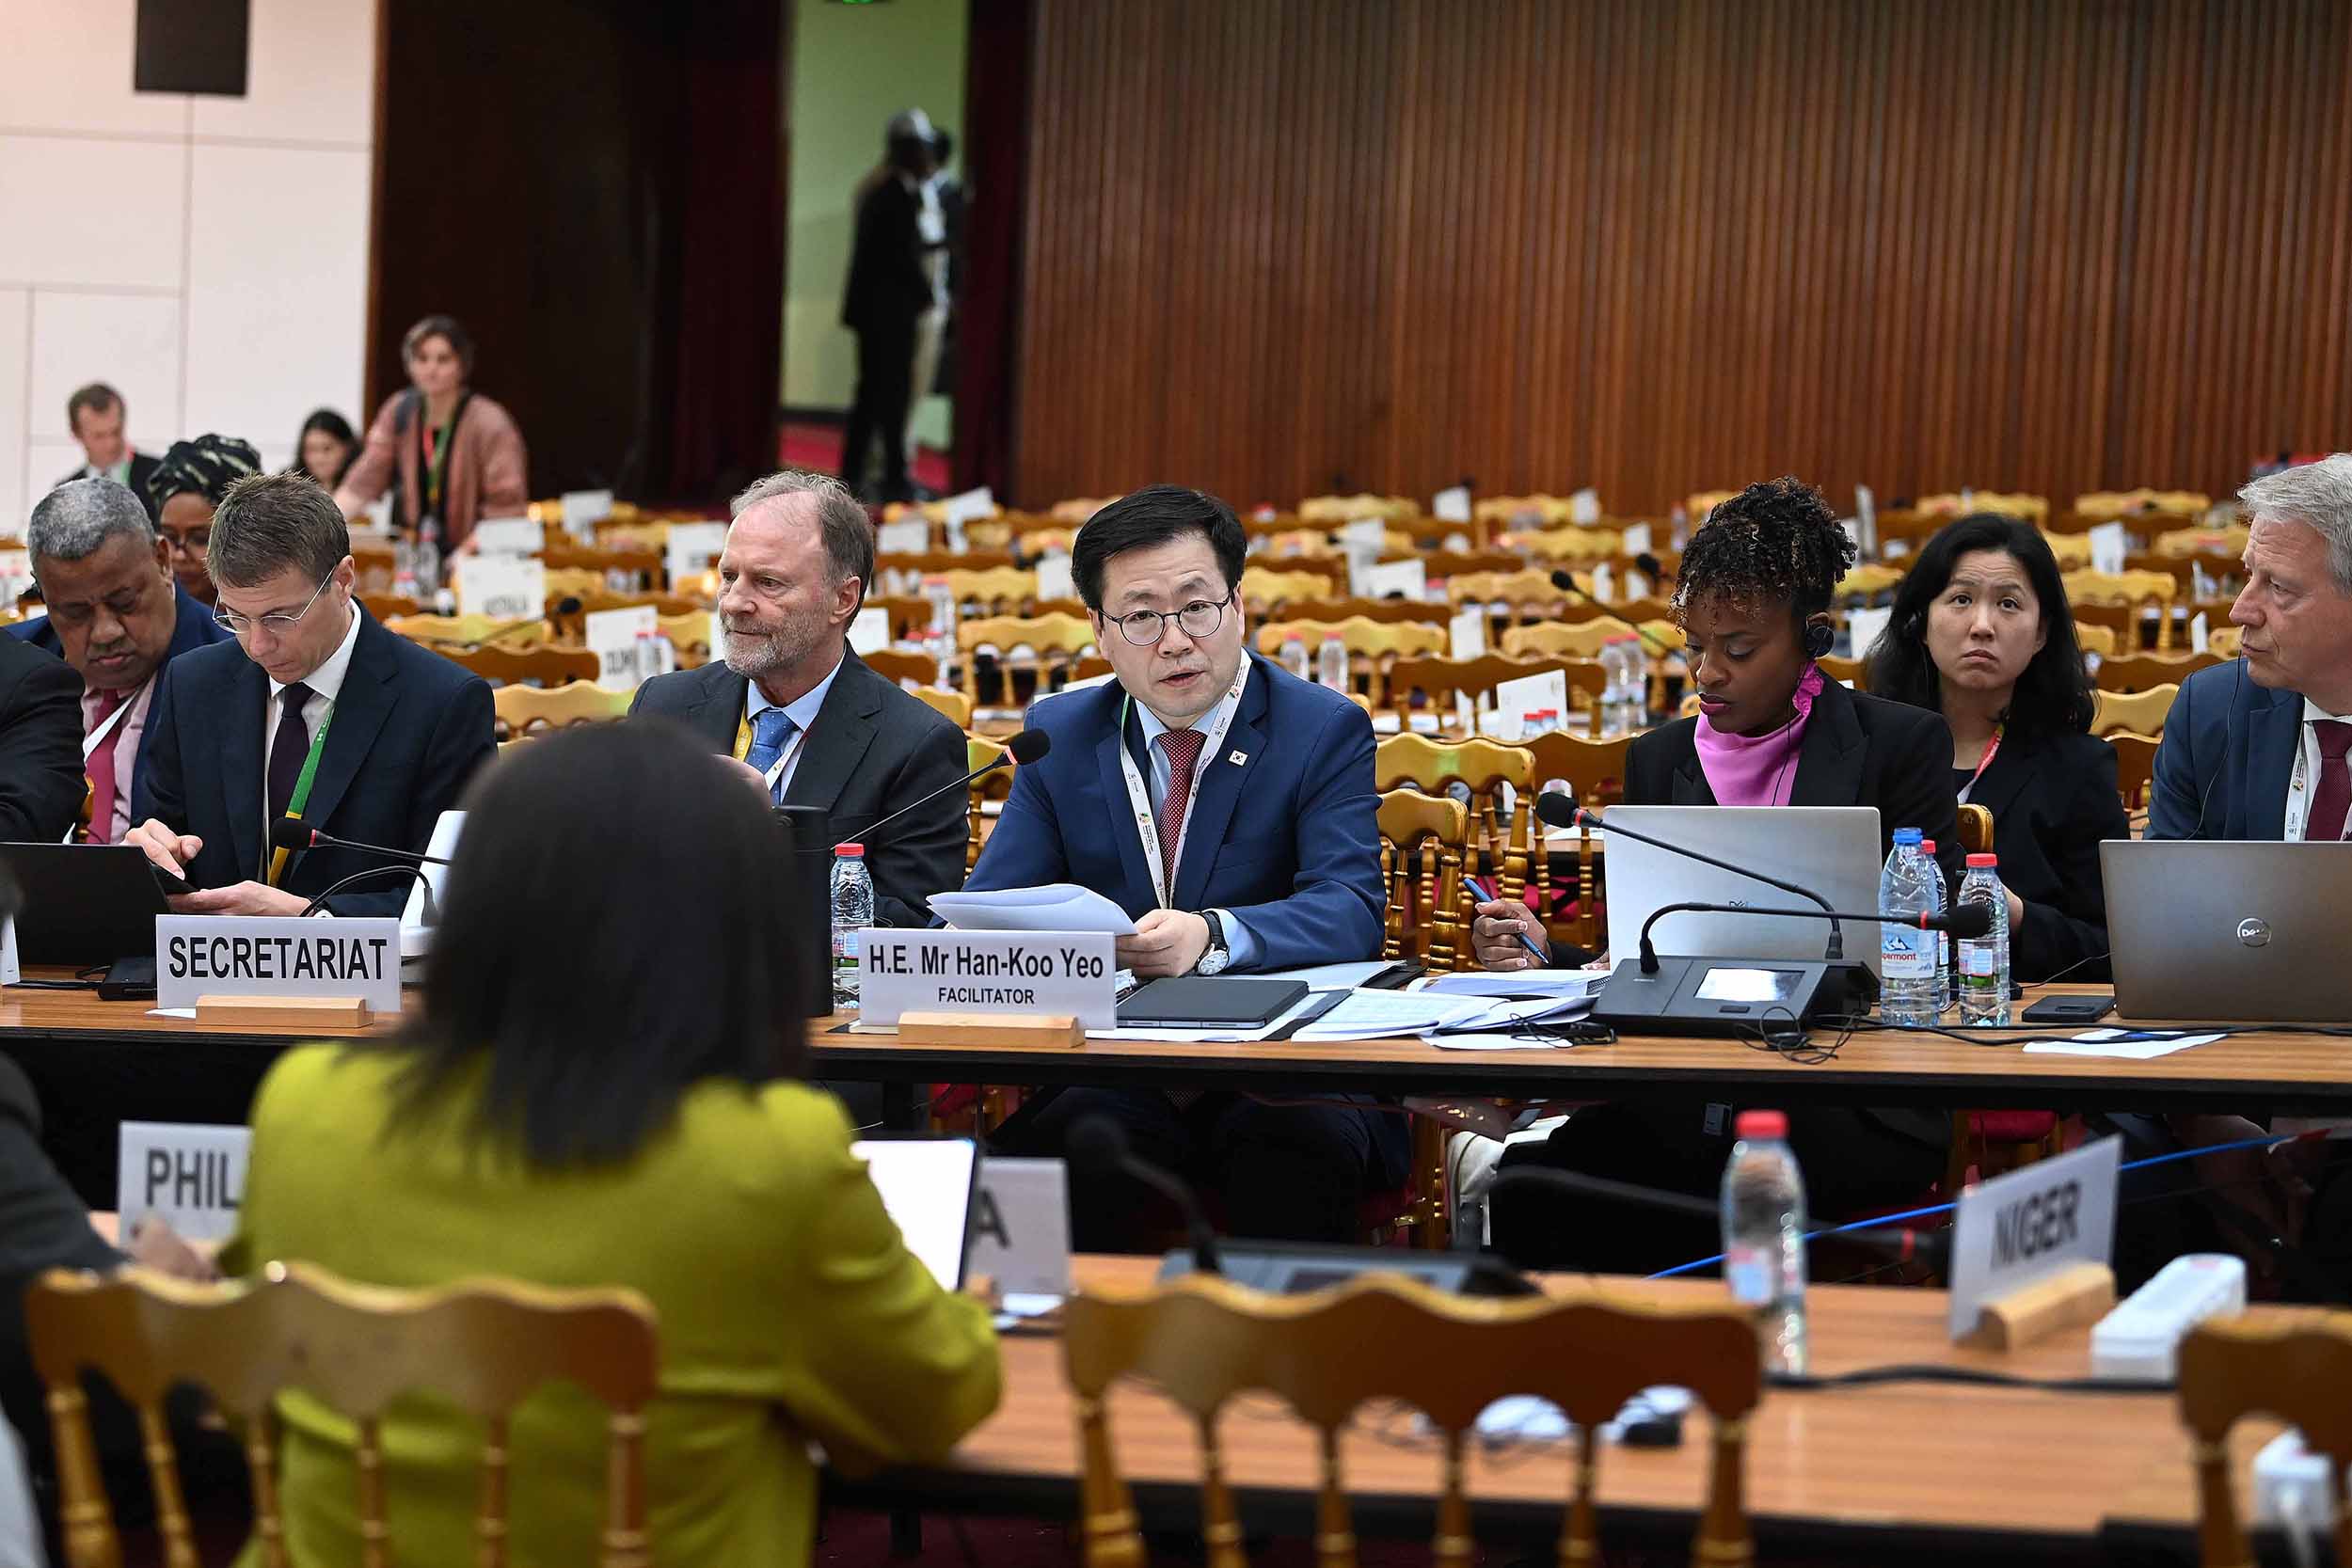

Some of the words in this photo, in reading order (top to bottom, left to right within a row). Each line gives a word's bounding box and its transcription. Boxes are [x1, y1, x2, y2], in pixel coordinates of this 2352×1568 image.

[168, 936, 388, 980] SECRETARIAT
[869, 944, 914, 974] H.E.
[921, 945, 949, 975] Mr
[956, 946, 1054, 977] Han-Koo
[1060, 948, 1104, 978] Yeo
[938, 987, 1035, 1005] FACILITATOR
[1994, 1180, 2081, 1264] NIGER
